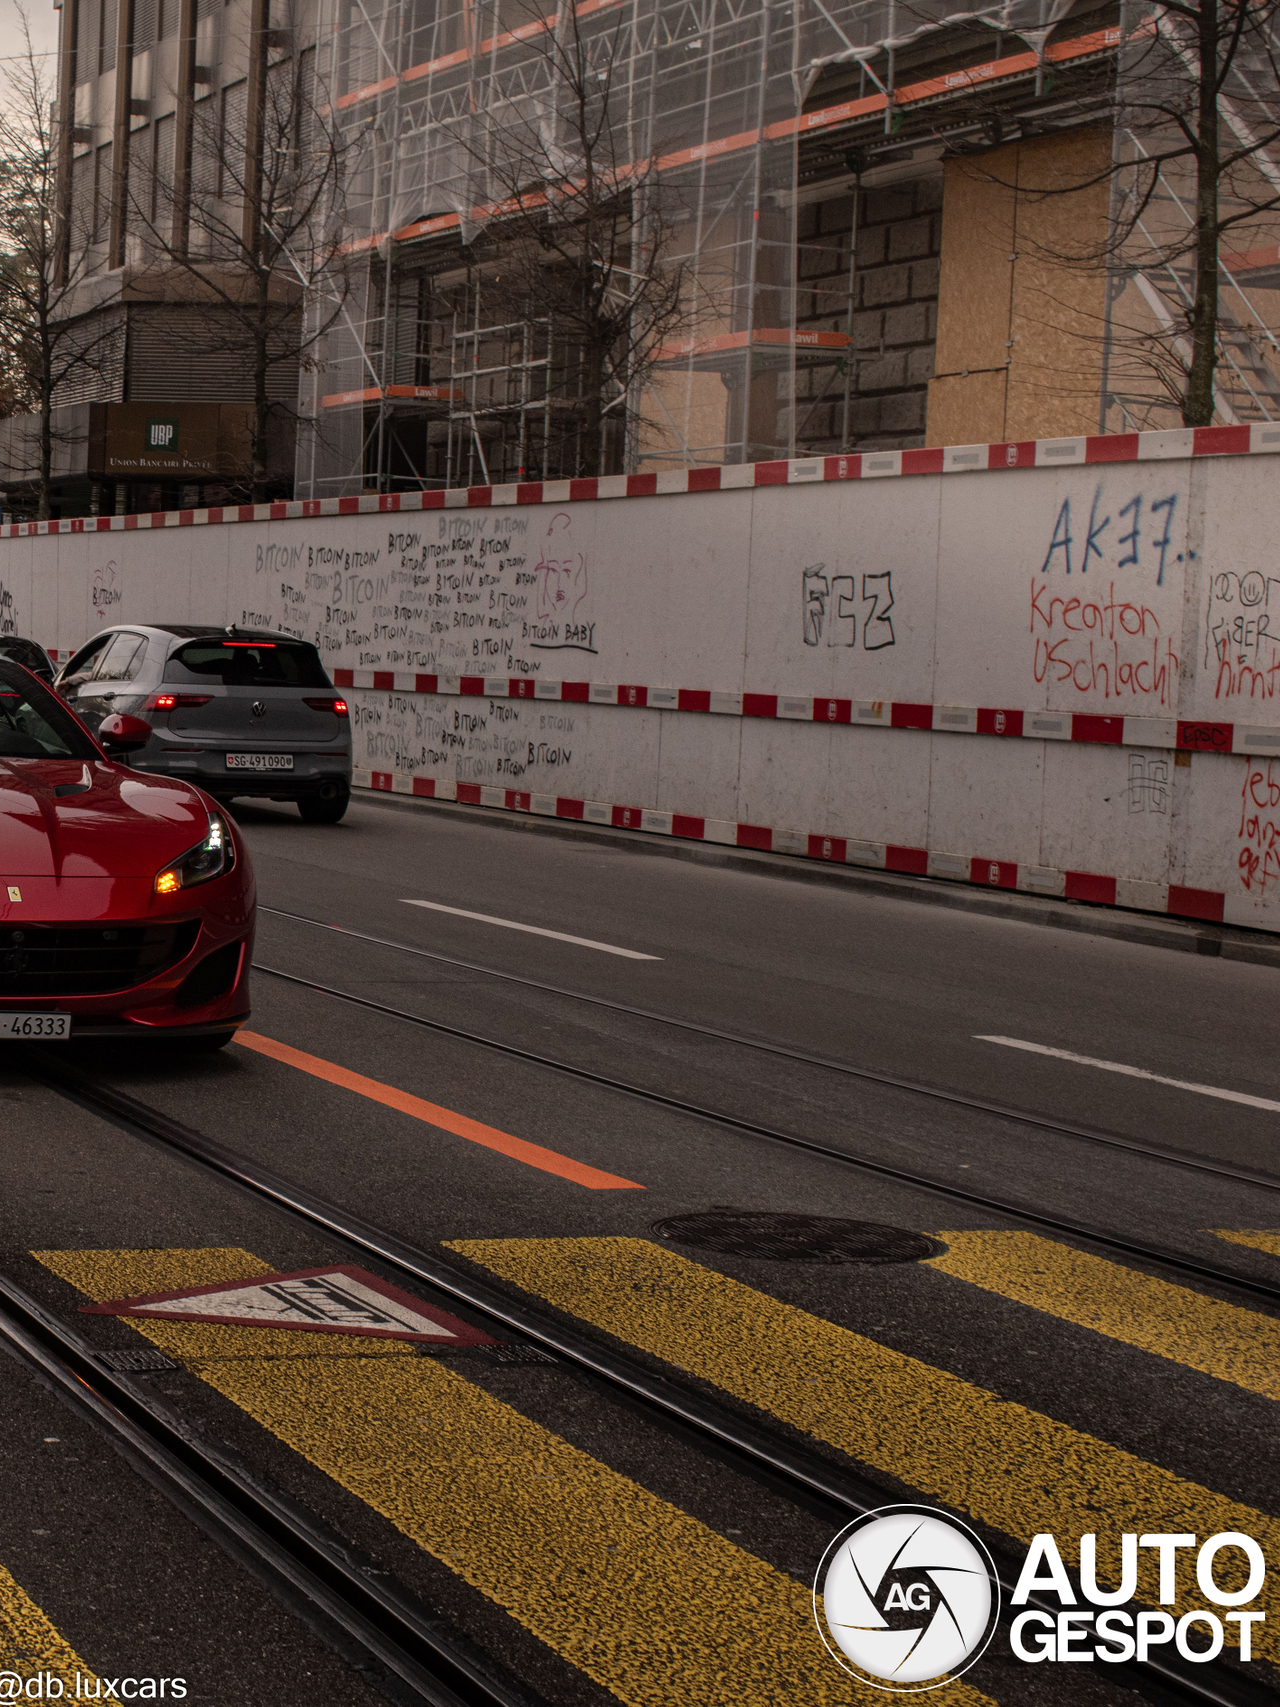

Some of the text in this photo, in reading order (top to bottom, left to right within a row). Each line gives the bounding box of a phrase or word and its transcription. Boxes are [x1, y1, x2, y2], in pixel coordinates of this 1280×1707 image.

[415, 388, 438, 397] Lawil
[150, 425, 173, 446] UBP
[440, 517, 486, 540] BITCOIN
[494, 518, 529, 536] BITCOIN
[388, 534, 420, 554] BITCOIN
[480, 537, 511, 558] BITCOIN
[256, 543, 304, 574] BITCOIN
[308, 547, 344, 568] BITCOIN
[344, 549, 380, 570] BITCOIN
[500, 558, 526, 571] BITCOIN
[332, 571, 389, 604] BITCOIN
[436, 572, 474, 590] BITCOIN
[281, 584, 306, 602] BITCOIN
[489, 590, 527, 609] BITCOIN
[242, 610, 272, 626] BITCOIN
[326, 606, 358, 624] BITCOIN
[394, 606, 423, 620] BITCOIN
[454, 612, 484, 628] BITCOIN
[346, 630, 372, 646] BITCOIN
[374, 623, 408, 640] BITCOIN
[522, 622, 596, 647] BITCOIN BABY
[315, 632, 342, 650] BITCOIN
[473, 639, 513, 656] BITCOIN
[360, 652, 381, 665] BITCOIN
[407, 651, 437, 666] BITCOIN
[464, 660, 496, 674] BITCOIN
[508, 655, 541, 672] BITCOIN
[389, 694, 417, 714] BITCOIN
[489, 701, 520, 722] BITCOIN
[355, 703, 382, 728] BITCOIN
[454, 710, 486, 733] BITCOIN
[540, 716, 574, 732] BITCOIN
[396, 752, 421, 769] BITCOIN
[422, 747, 448, 765] BITCOIN
[527, 742, 572, 766] BITCOIN
[497, 759, 526, 776] BITCOIN
